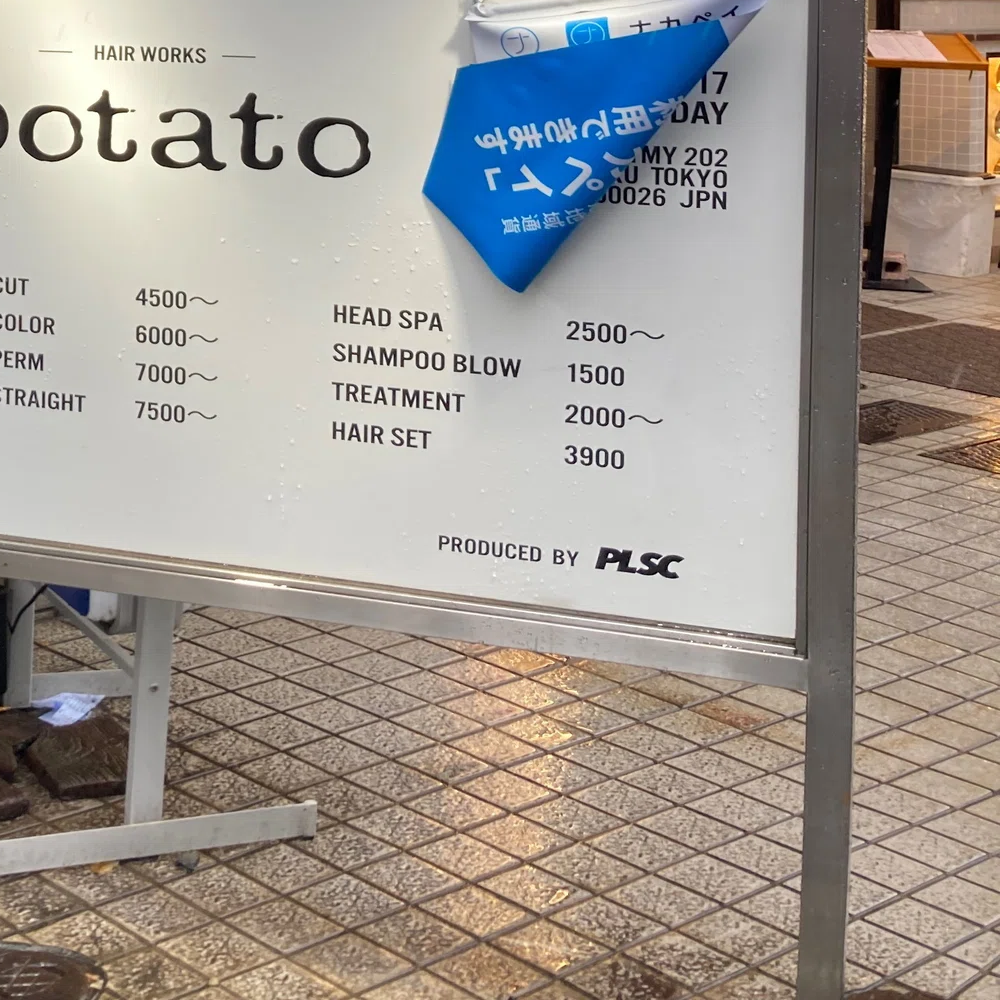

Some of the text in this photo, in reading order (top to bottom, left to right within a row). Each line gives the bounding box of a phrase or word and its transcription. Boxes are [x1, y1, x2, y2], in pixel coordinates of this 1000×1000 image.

[94, 45, 207, 64] HAIR WORKS
[683, 147, 728, 168] 202
[650, 166, 728, 189] TOKYO
[680, 189, 727, 210] JPN
[333, 304, 444, 332] HEAD SPA
[332, 343, 522, 378] SHAMPOO BLOW
[567, 363, 625, 387] 1500
[332, 381, 466, 413] TREATMENT
[332, 421, 432, 450] HAIR SET
[564, 445, 625, 469] 3900
[438, 535, 685, 579] PRODUCED BY PLSC
